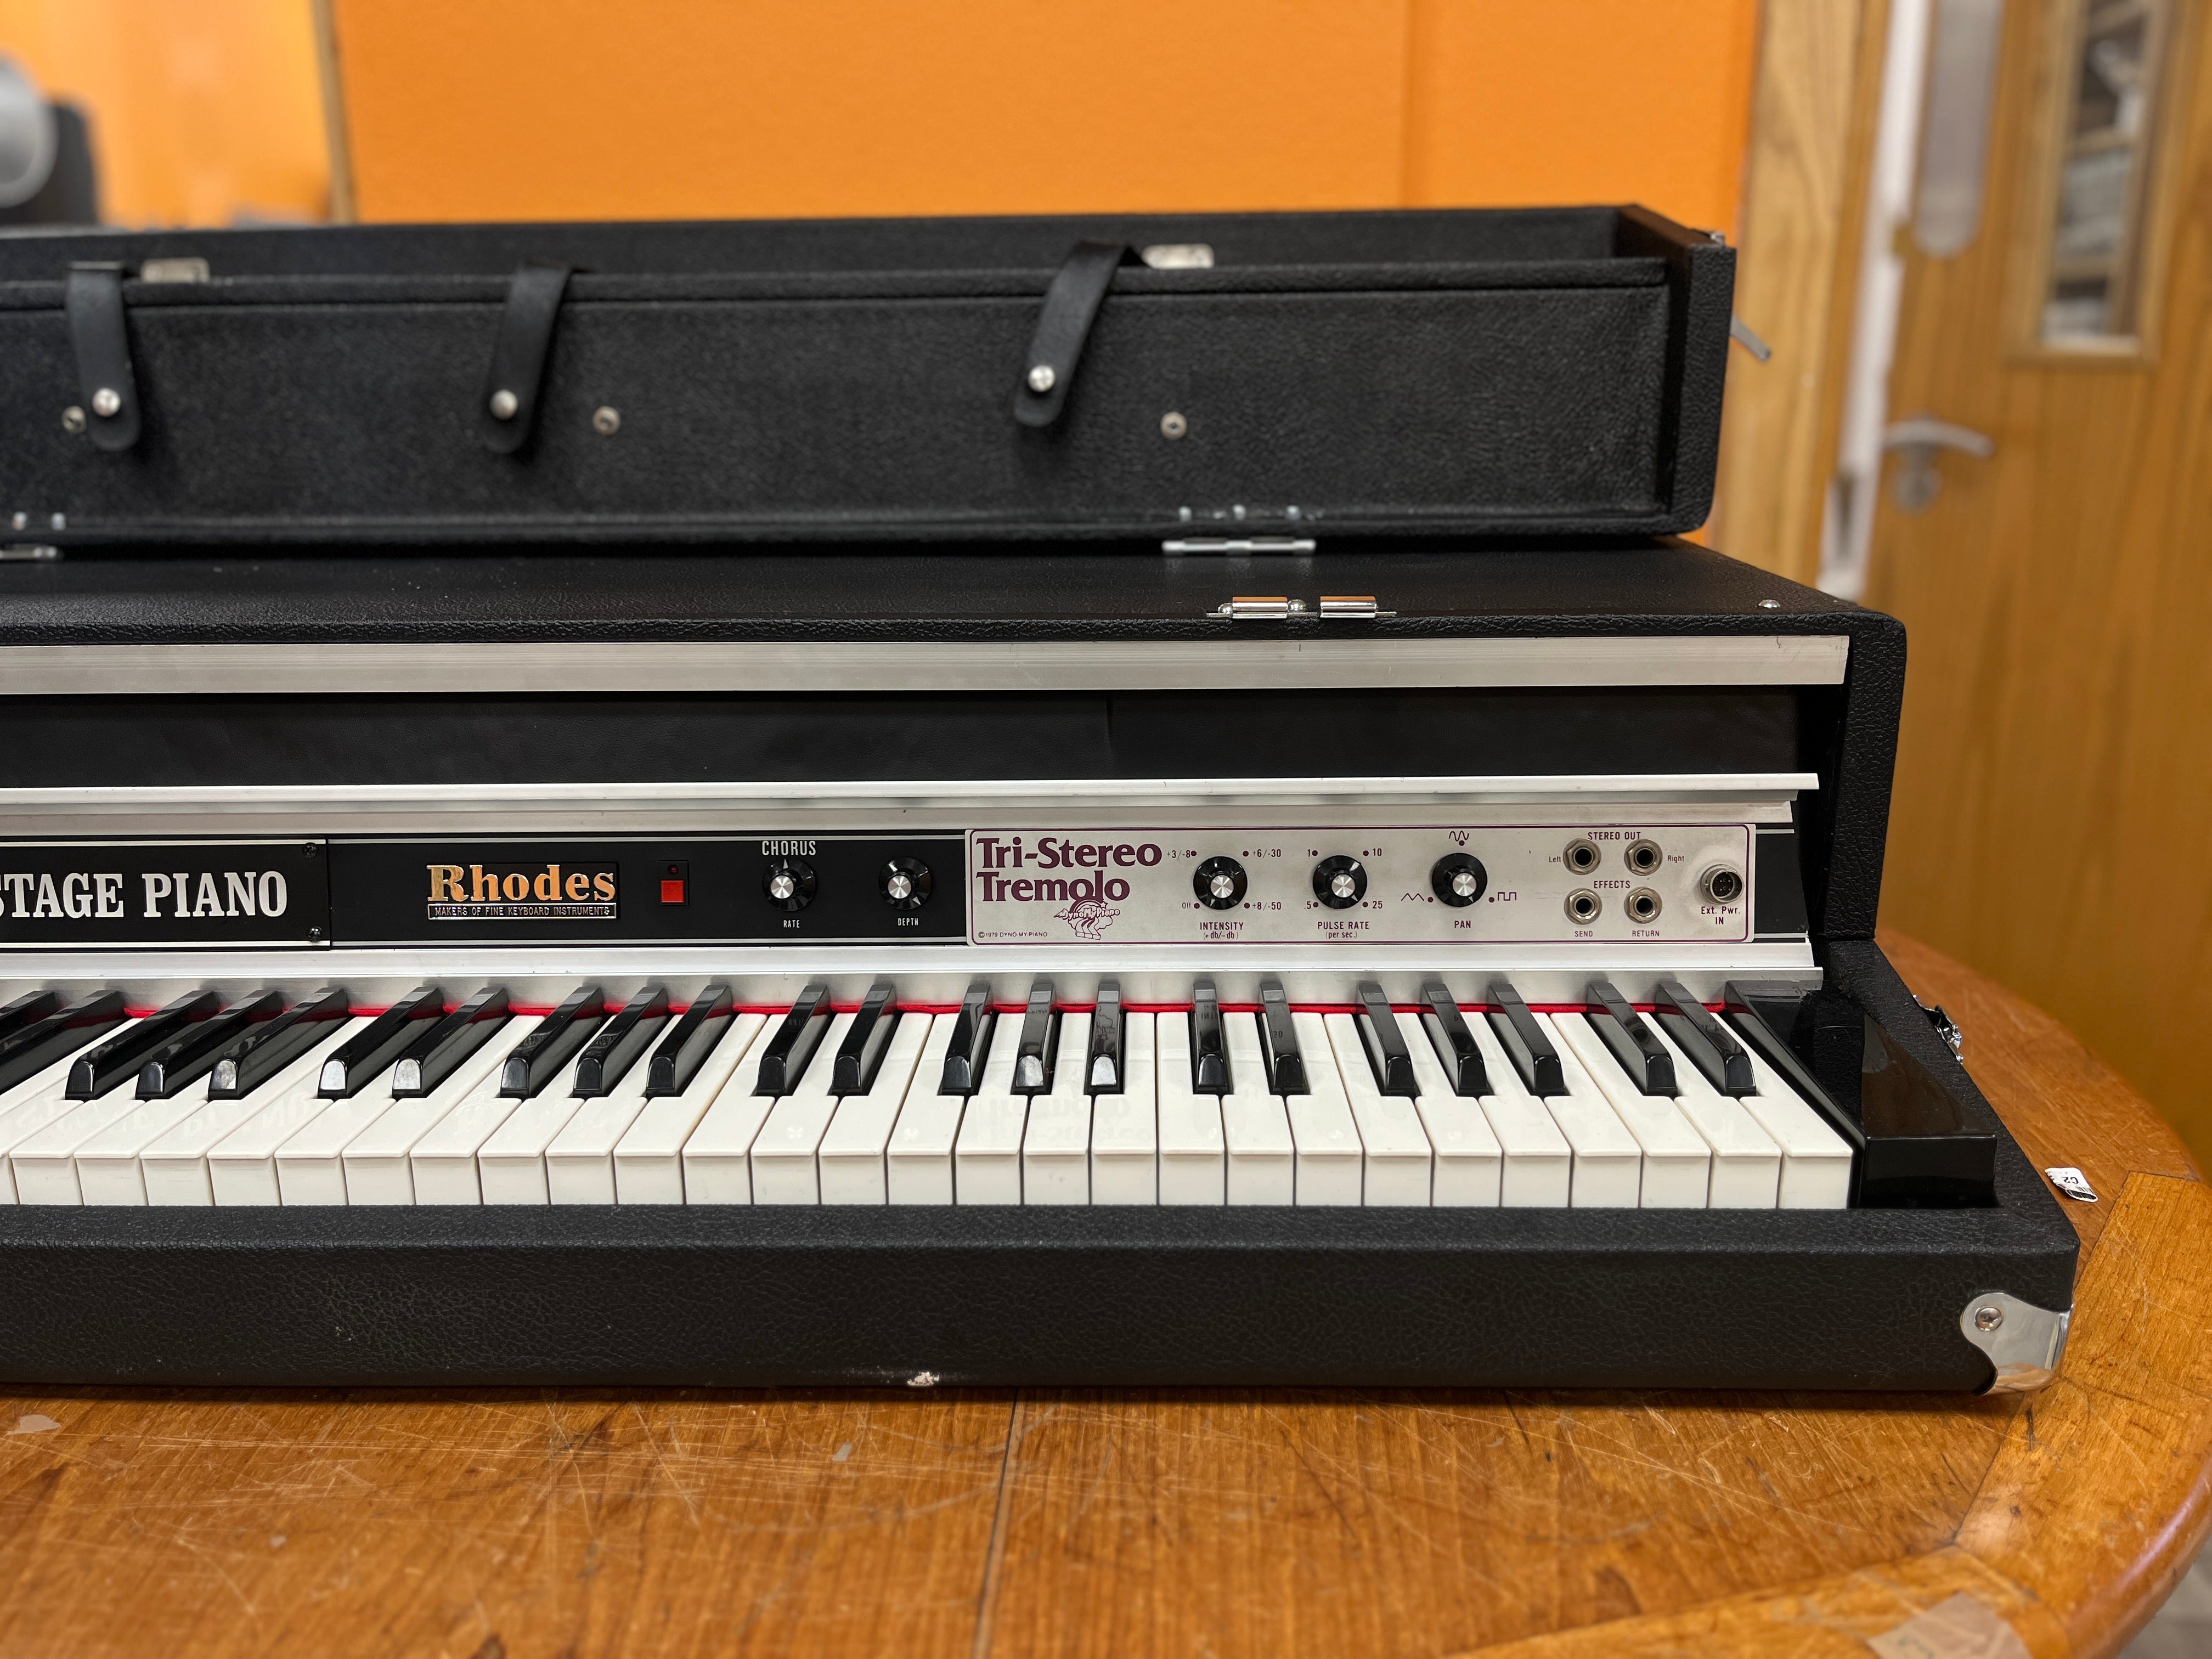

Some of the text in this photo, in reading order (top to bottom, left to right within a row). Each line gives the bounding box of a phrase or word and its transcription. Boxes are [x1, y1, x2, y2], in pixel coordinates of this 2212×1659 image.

[1588, 831, 1641, 840] STEREO OUT
[762, 840, 816, 856] CHORUS
[976, 836, 1162, 869] Tri-Stereo
[1373, 848, 1382, 856] 10
[1667, 854, 1685, 863] Right
[426, 864, 616, 902] Rhodes
[976, 870, 1130, 902] Tremolo
[1594, 880, 1630, 889] EFFECTS
[0, 871, 287, 919] TAGE PIANO
[1372, 900, 1383, 909] 25
[435, 906, 610, 916] MAKERS OF FINE KEYBOARD INSTRUMENTS
[1701, 906, 1740, 915] Ext. Pwr.
[783, 919, 800, 929] RATE
[898, 918, 919, 926] DEPTH
[1317, 921, 1369, 930] PULSE RATE
[1454, 920, 1471, 929] PAN
[1715, 917, 1724, 925] IN
[1200, 922, 1244, 930] INTENSITY
